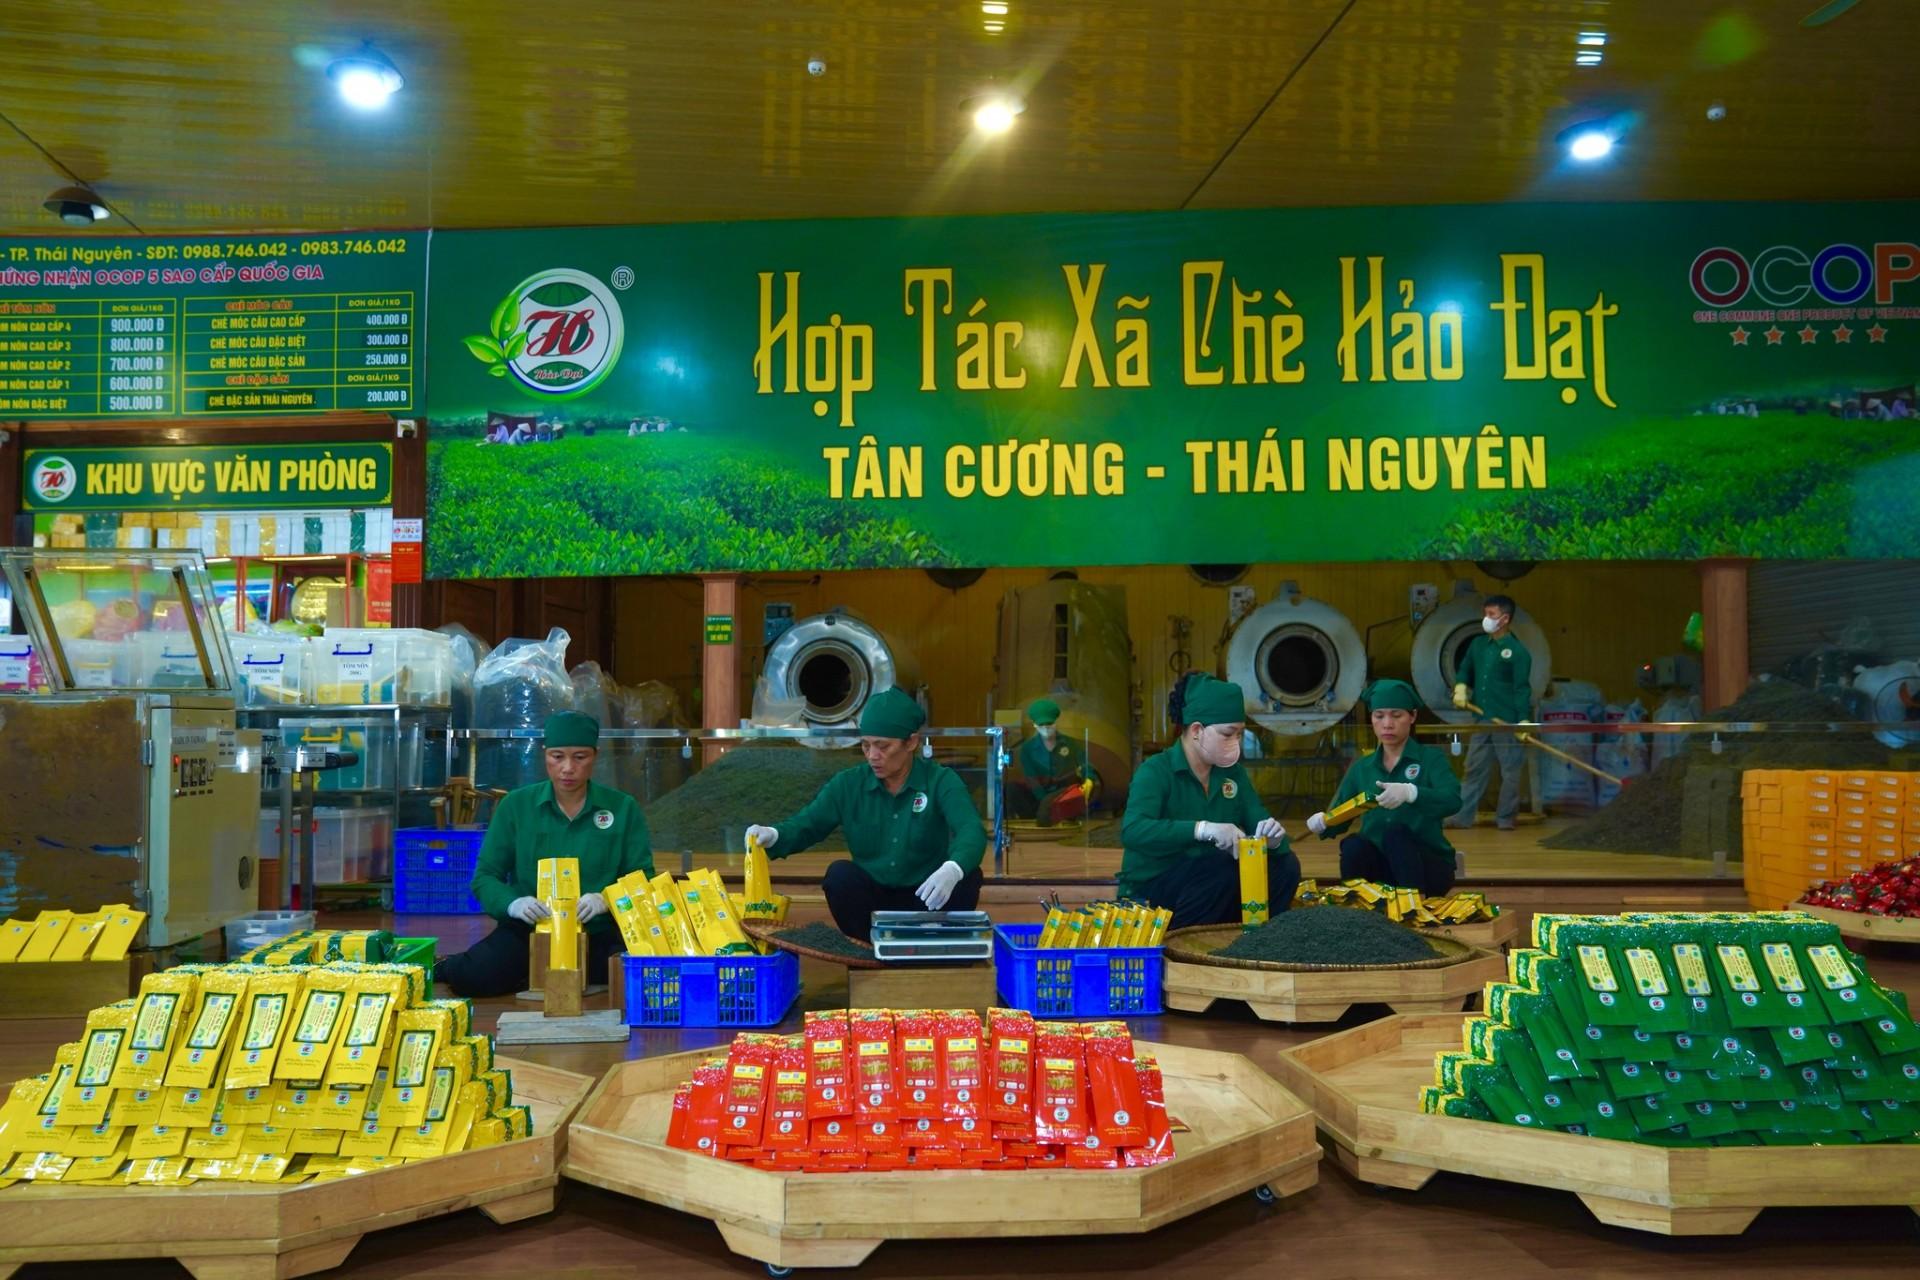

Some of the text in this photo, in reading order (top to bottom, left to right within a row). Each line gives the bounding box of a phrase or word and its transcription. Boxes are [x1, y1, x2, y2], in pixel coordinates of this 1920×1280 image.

[10, 247, 29, 261] TP.
[35, 246, 67, 261] Thái
[72, 246, 133, 265] Nguyên
[146, 245, 178, 260] SĐT:
[183, 243, 287, 259] 0988.746.042
[301, 239, 406, 256] 0983.746.042
[43, 266, 91, 289] NHẬN
[95, 269, 145, 285] OCOP
[148, 269, 158, 283] 5
[162, 268, 196, 284] SAO
[199, 260, 235, 283] CẤP
[238, 260, 290, 283] QUỐC
[292, 264, 324, 281] GIA
[1689, 243, 1920, 307] OCOP
[111, 318, 154, 332] 900.000
[270, 316, 287, 328] CAO
[288, 313, 305, 327] CẤP
[365, 314, 399, 325] 400.000
[110, 337, 153, 352] 800.000
[366, 334, 400, 345] 300.000
[753, 253, 1619, 428] Hợp Tác Xã Chè Hảo Đạt
[110, 358, 153, 371] 700.000
[365, 354, 399, 365] 250.000
[109, 377, 153, 391] 600.000
[109, 396, 153, 410] 500.000
[262, 393, 280, 405] THÁI
[367, 391, 399, 402] 200.000
[822, 424, 1547, 499] TÂN CƯƠNG - THÁI NGUYÊN
[86, 451, 376, 501] KHU VỰC VĂN PHÒNG
